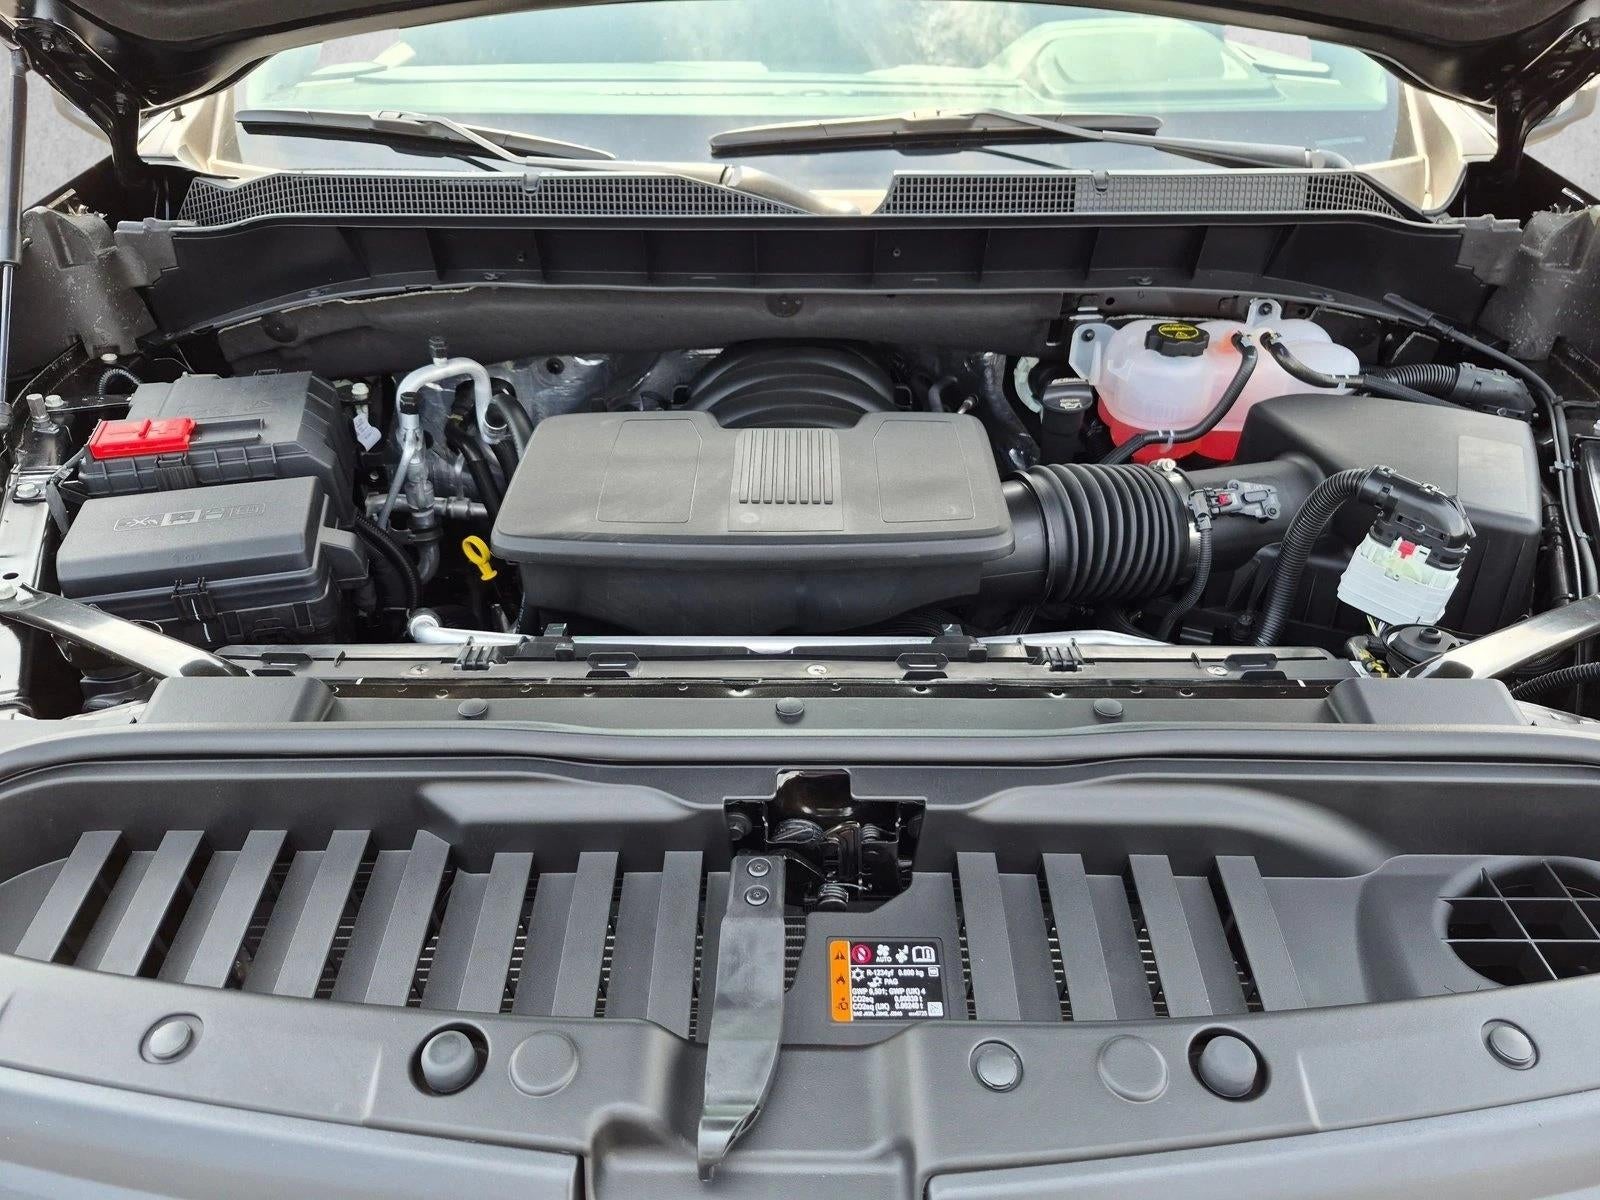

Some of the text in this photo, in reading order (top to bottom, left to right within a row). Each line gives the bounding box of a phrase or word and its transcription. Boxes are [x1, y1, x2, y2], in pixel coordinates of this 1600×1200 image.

[866, 969, 894, 977] R-1234yf
[915, 969, 925, 978] kg
[905, 988, 920, 996] (UK)
[875, 1002, 890, 1011] (UK)
